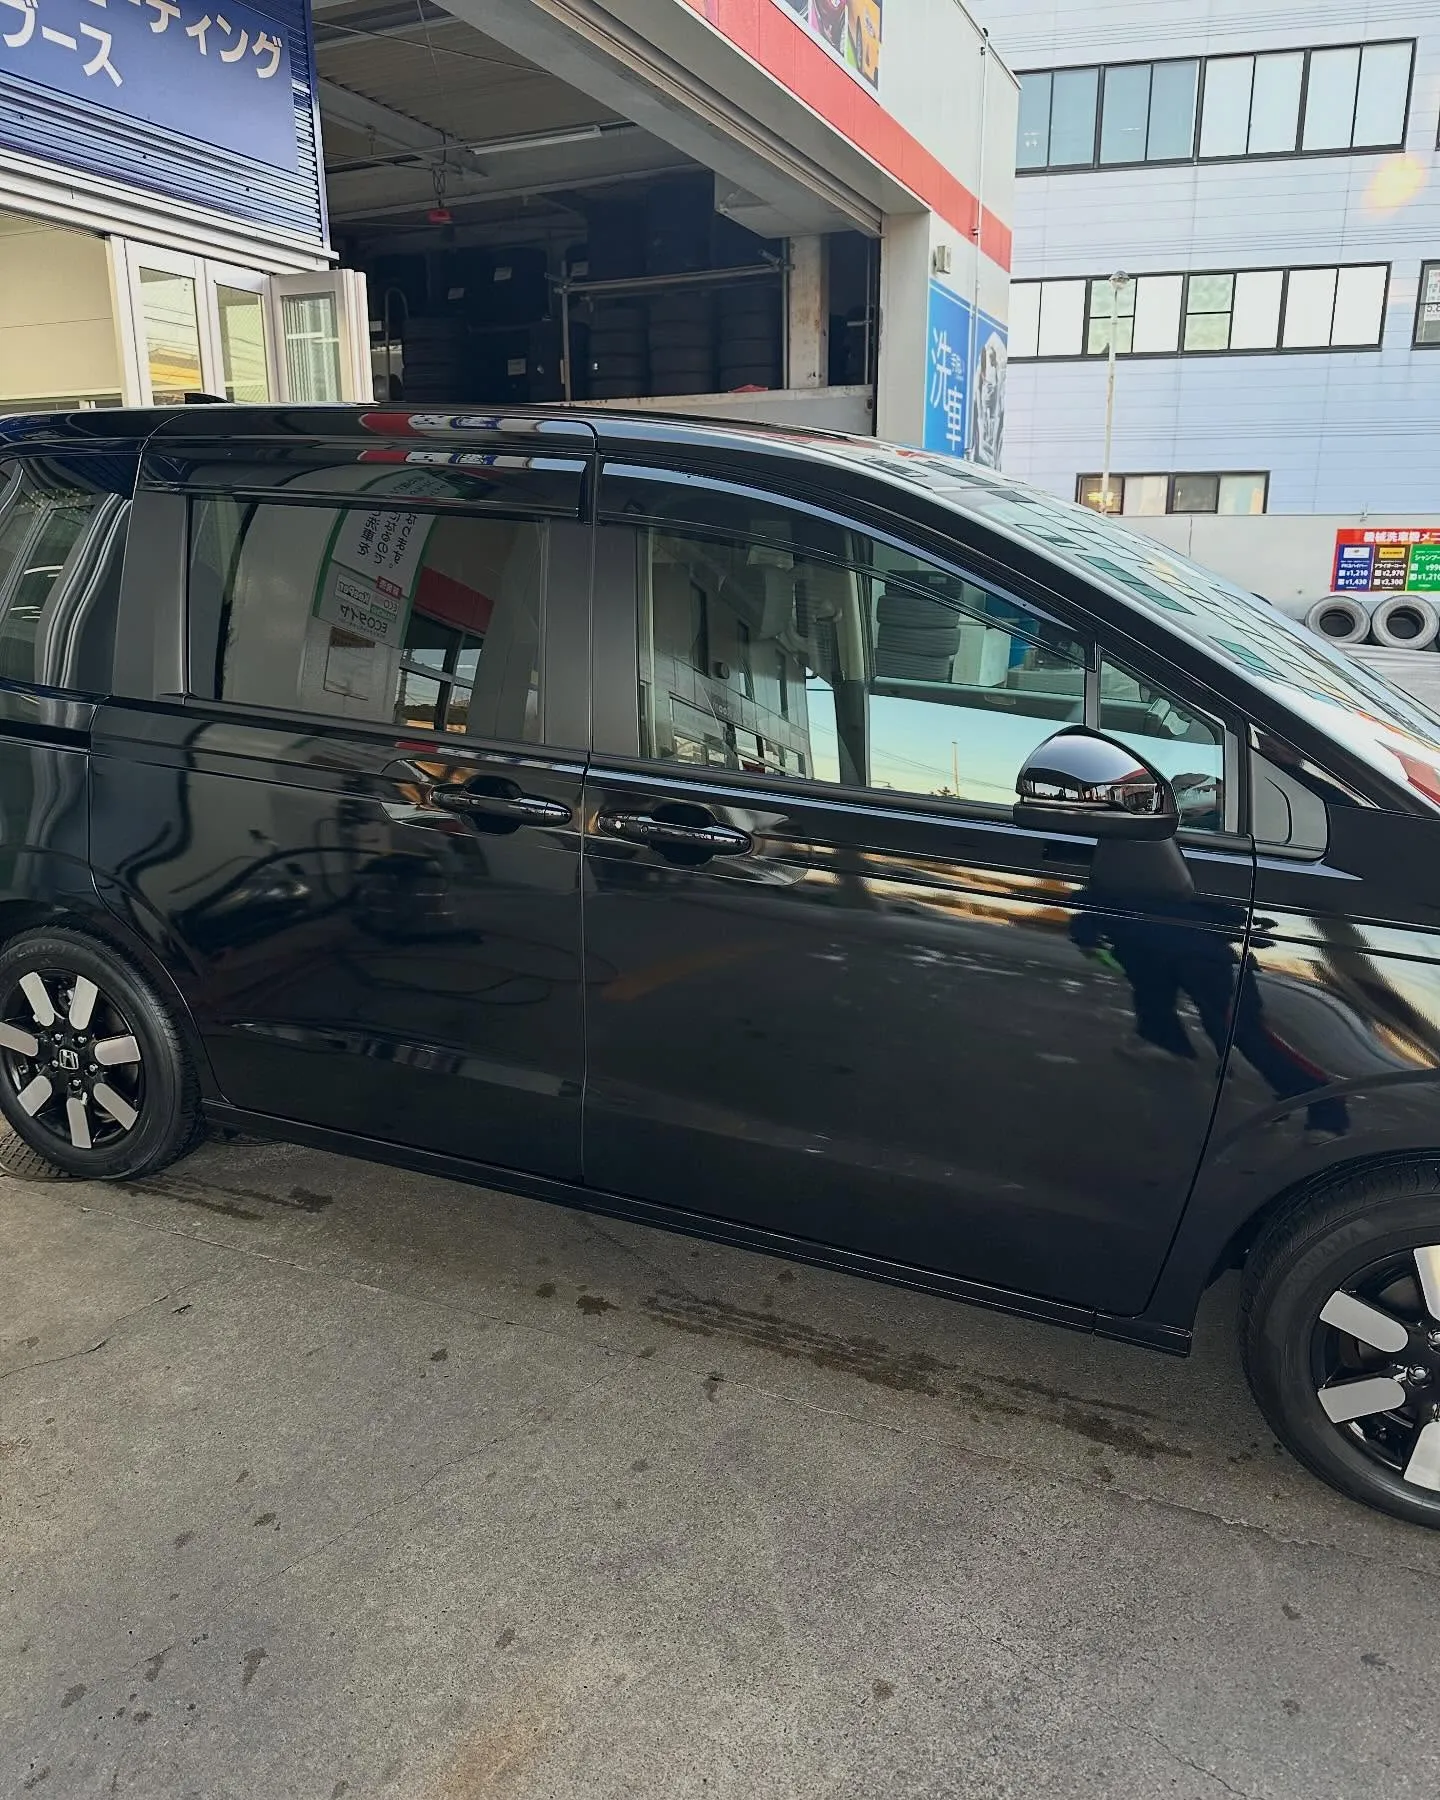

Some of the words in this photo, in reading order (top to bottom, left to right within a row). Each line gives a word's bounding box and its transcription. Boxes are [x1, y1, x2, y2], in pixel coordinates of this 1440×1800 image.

[0, 0, 123, 88] ブース
[88, 0, 283, 79] ティング
[929, 327, 964, 452] 洗車
